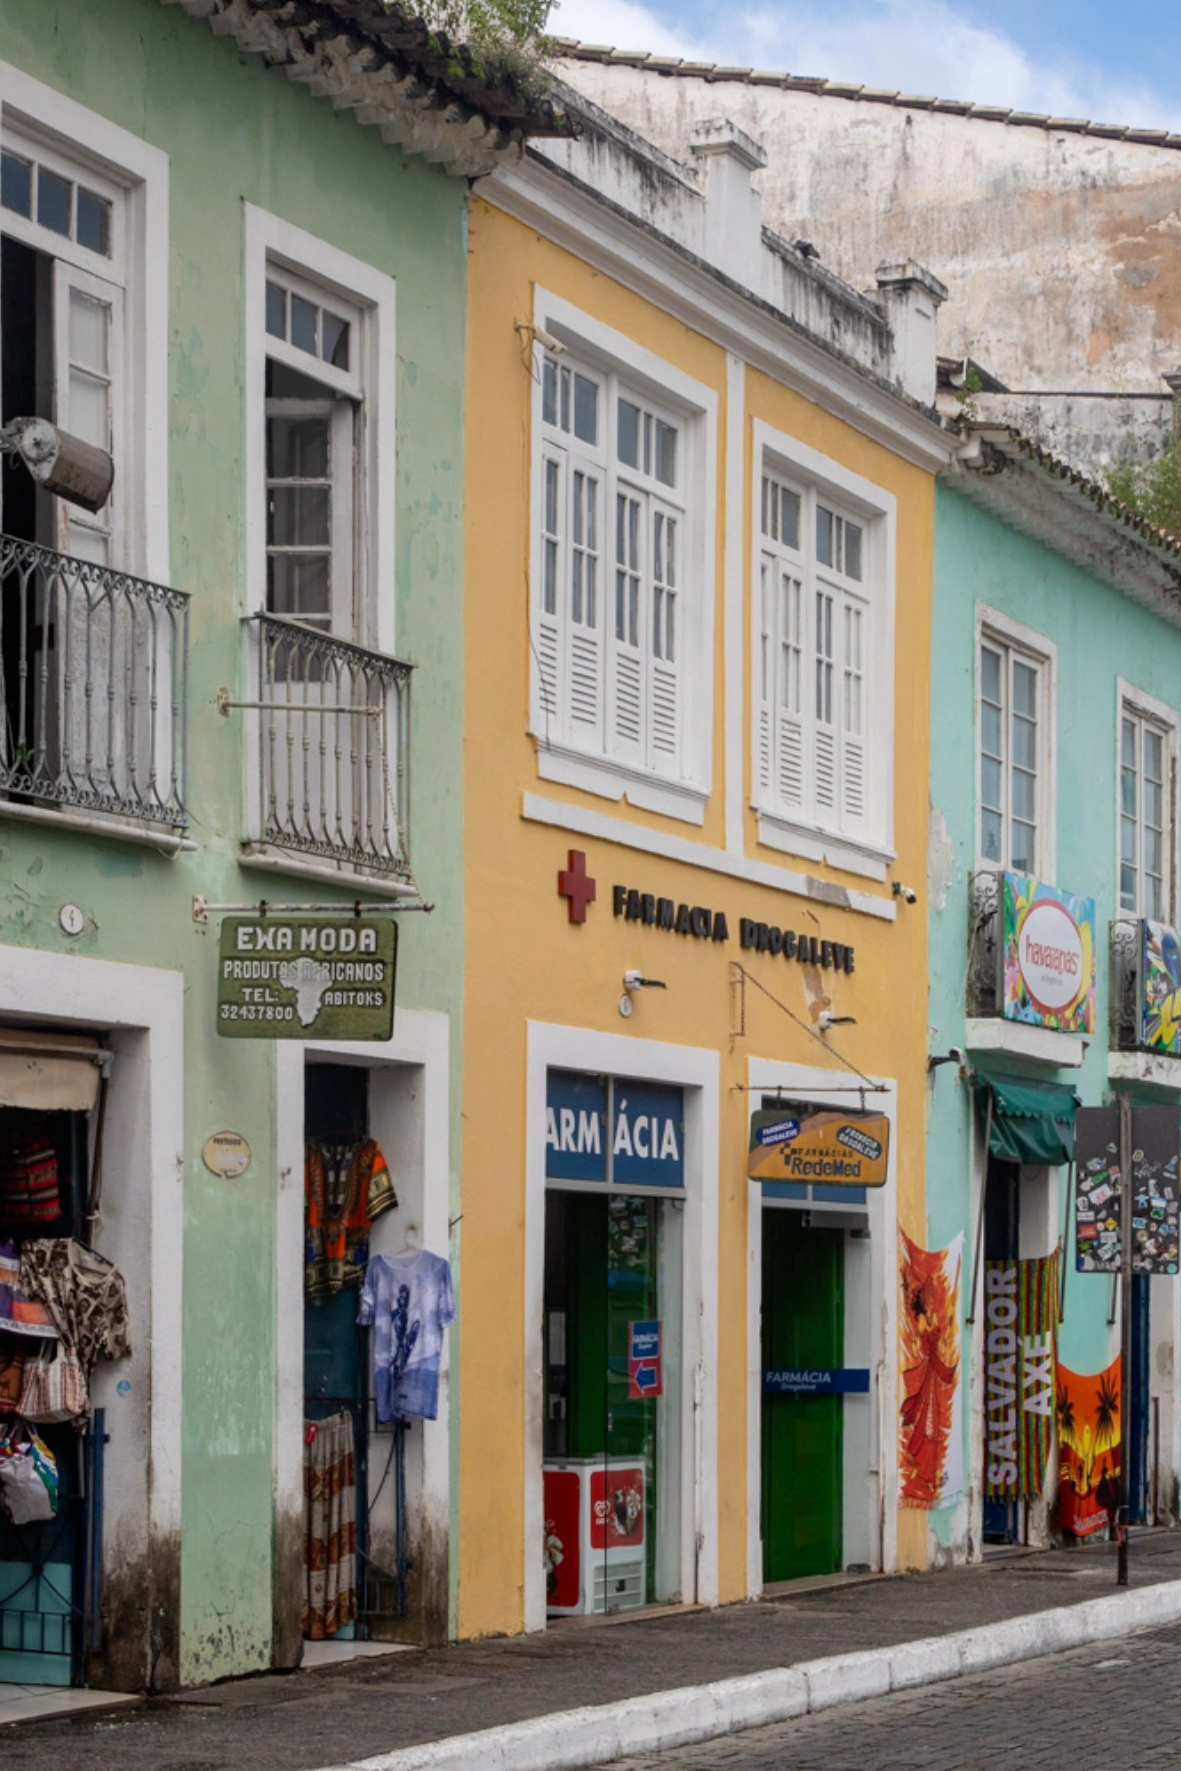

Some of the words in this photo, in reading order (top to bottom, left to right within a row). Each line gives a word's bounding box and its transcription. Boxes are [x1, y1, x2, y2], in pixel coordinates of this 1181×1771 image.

[300, 927, 377, 952] MODA
[612, 884, 729, 941] FARMACIA
[740, 917, 855, 975] DROGALEVE
[1025, 934, 1079, 976] havaianas
[223, 960, 298, 980] PRODUTOS
[241, 987, 280, 1002] TEL:
[324, 991, 384, 1006] ABITOKS
[220, 1005, 293, 1020] 32437800
[791, 1157, 862, 1177] RedeMed
[765, 1369, 832, 1384] FARMÁCIA
[986, 1267, 1018, 1486] SALVADOR
[1018, 1331, 1051, 1416] AXÉ
